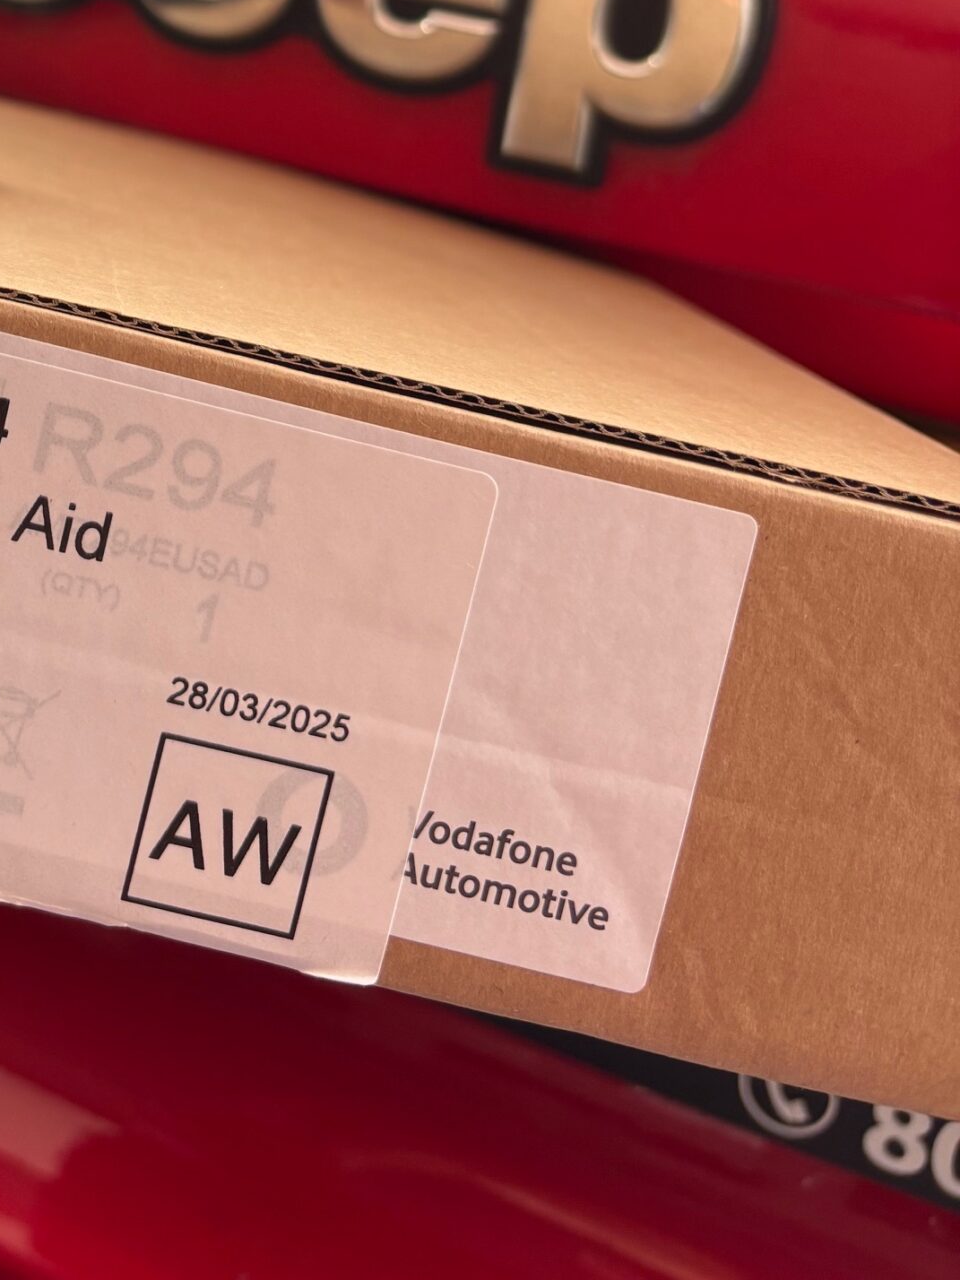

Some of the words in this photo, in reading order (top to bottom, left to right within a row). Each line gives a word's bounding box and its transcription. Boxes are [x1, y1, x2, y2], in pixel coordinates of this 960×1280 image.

[33, 401, 277, 529] R294
[11, 495, 115, 563] Aid
[166, 675, 351, 743] 28/03/2025
[148, 798, 303, 887] AW
[409, 807, 578, 877] Vodafone
[398, 851, 610, 932] Automotive
